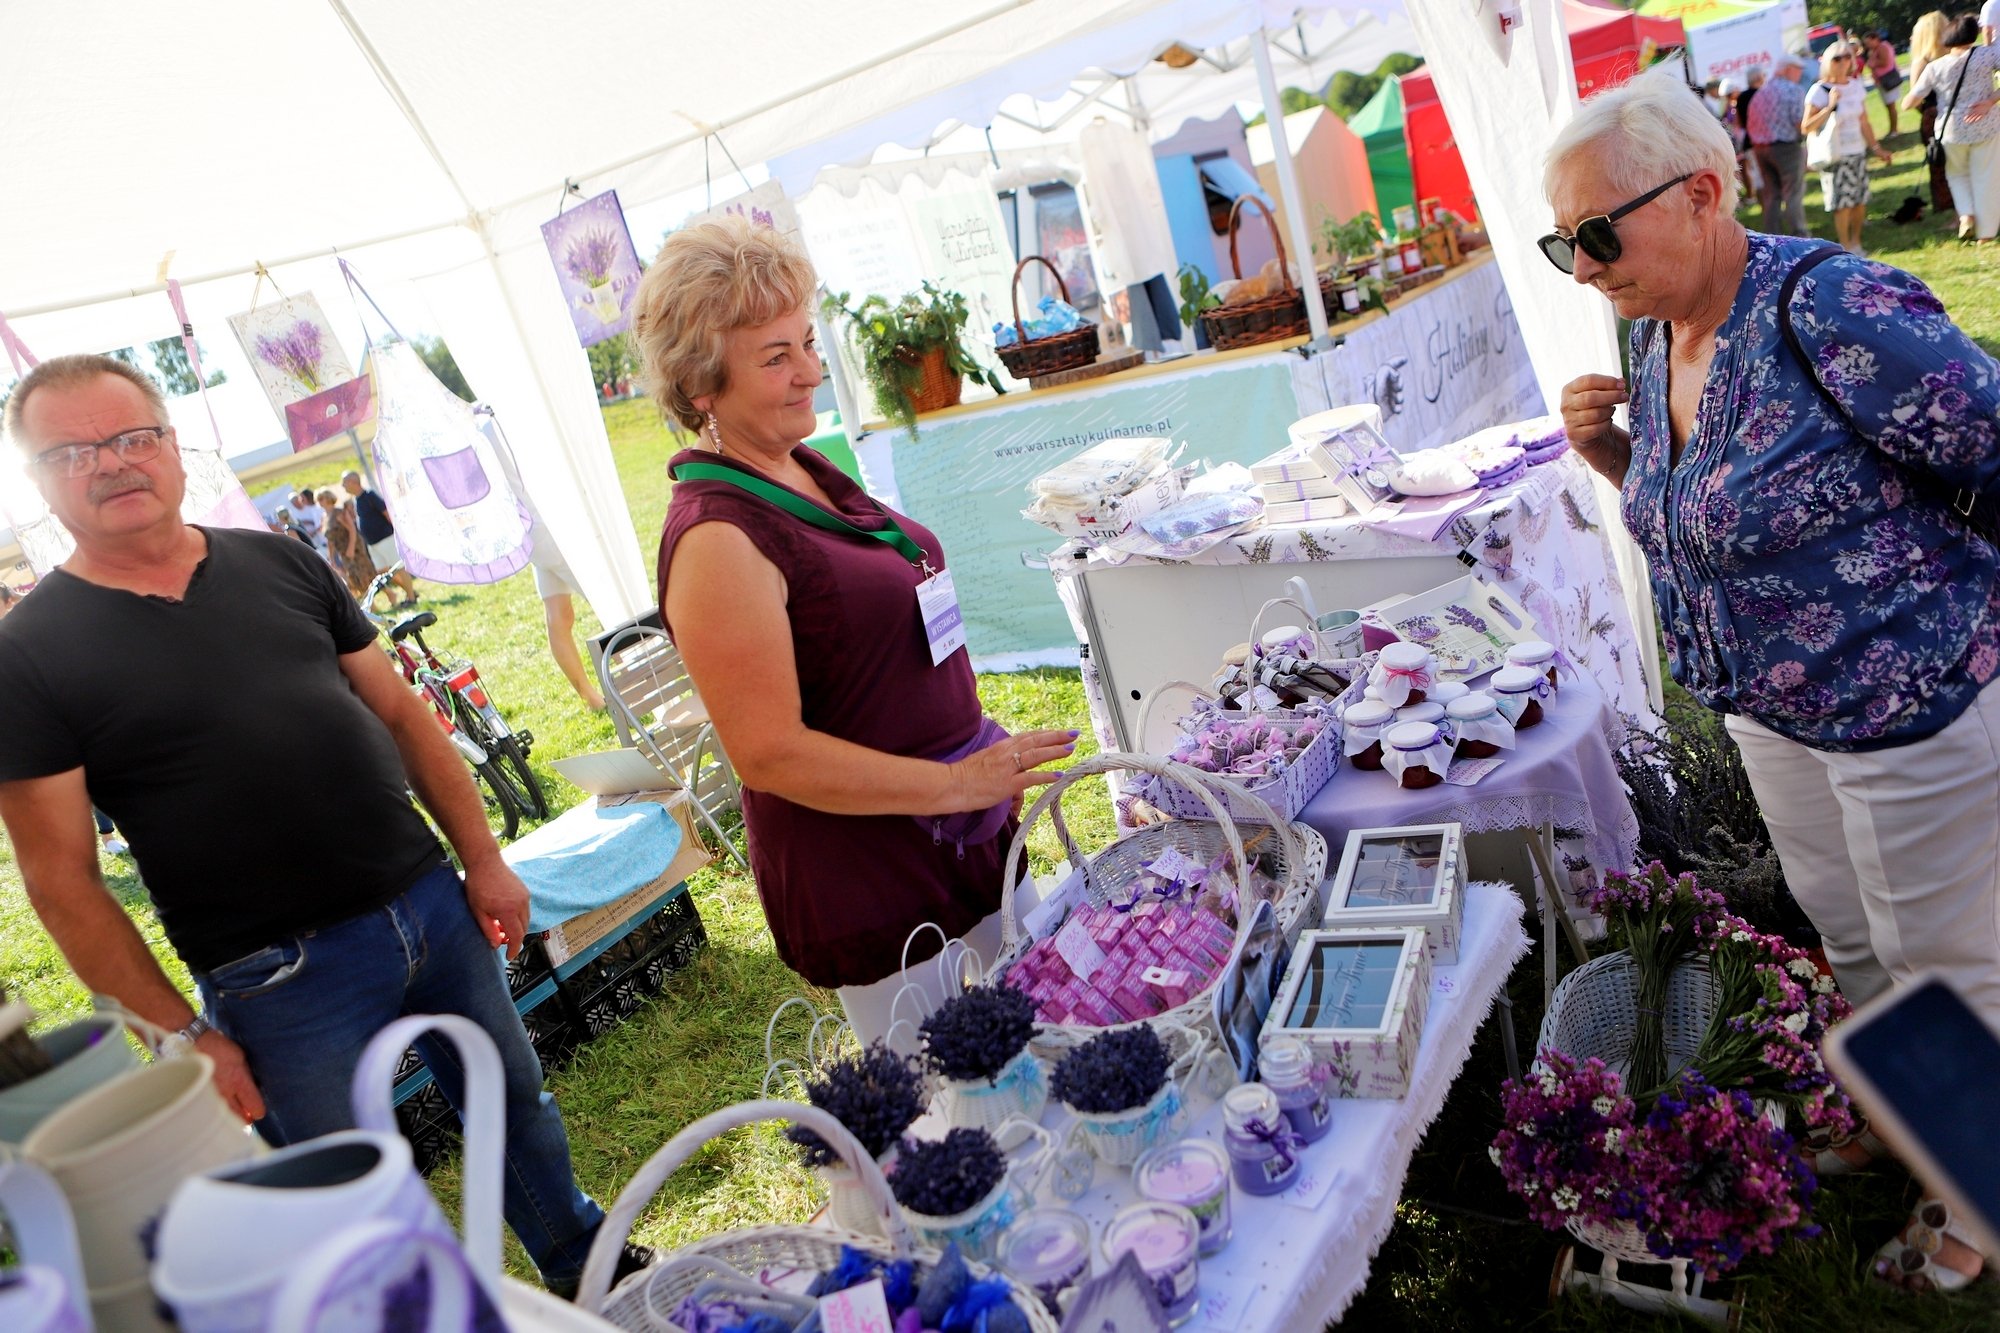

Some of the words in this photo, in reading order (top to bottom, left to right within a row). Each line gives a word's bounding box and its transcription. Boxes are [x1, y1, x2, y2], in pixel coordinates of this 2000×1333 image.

[1422, 314, 1489, 404] Holiday
[994, 418, 1172, 459] www.warsztatykulinarne.pl
[931, 611, 958, 637] WYSTAWCA
[1331, 951, 1369, 990] Time
[1321, 992, 1356, 1025] Tea
